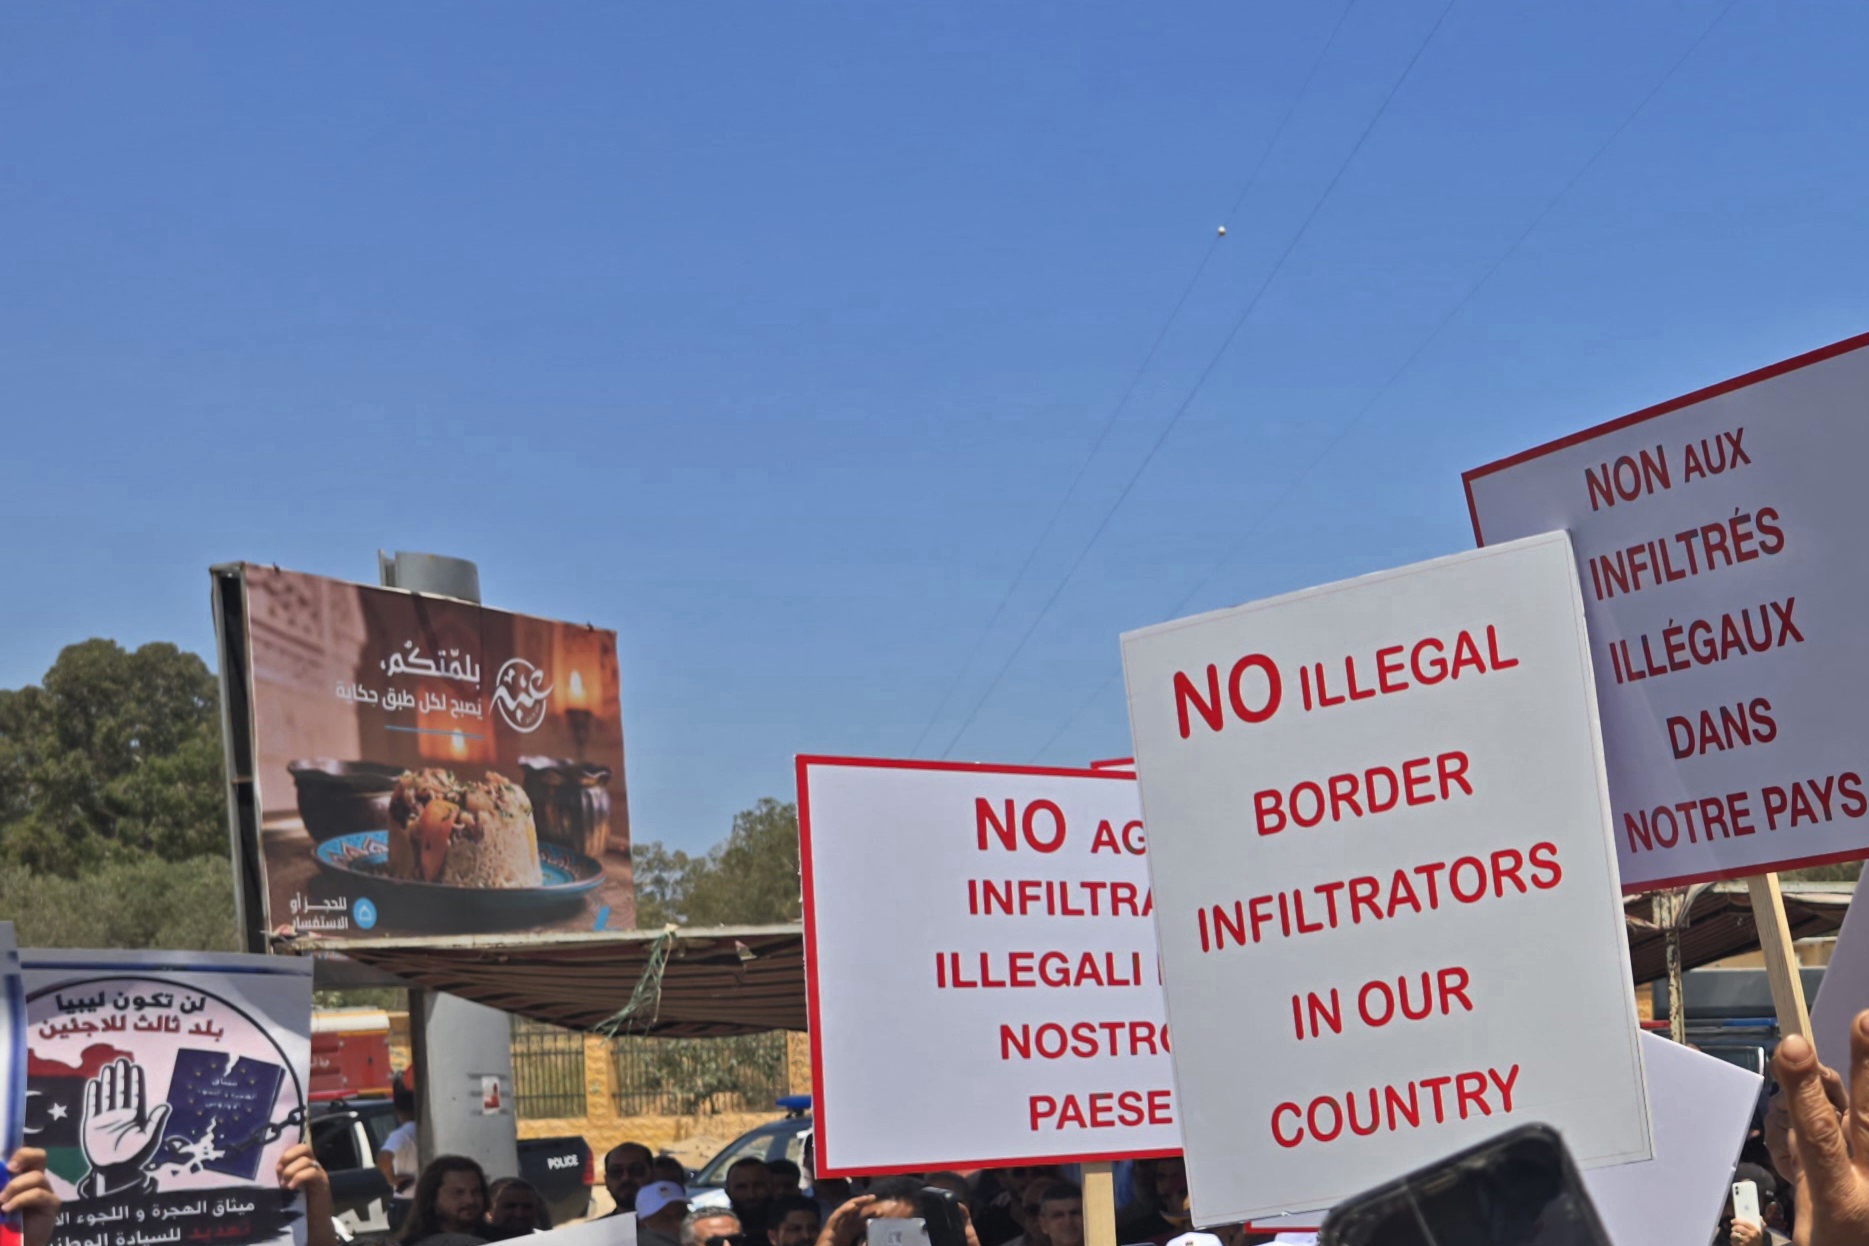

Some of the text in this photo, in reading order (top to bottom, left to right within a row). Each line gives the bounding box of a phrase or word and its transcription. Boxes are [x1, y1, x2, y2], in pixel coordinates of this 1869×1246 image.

[1584, 427, 1752, 511] NON AUX
[1588, 506, 1786, 602] INFILTRÉS
[1608, 596, 1805, 685] ILLÉGAUX
[382, 688, 415, 710] طبق
[1172, 624, 1519, 740] NO ILLEGAL
[419, 692, 446, 714] لكل
[1666, 697, 1778, 760] DANS
[1253, 749, 1473, 837] BORDER
[975, 798, 1146, 855] NO AG
[1623, 771, 1868, 854] NOTRE PAYS
[290, 891, 301, 915] أو
[1198, 842, 1563, 953] INFILTRATORS
[293, 915, 348, 930] الاستفسار
[936, 951, 1141, 988] ILLEGALI
[55, 991, 207, 1014] لن تكون ليبيا
[1291, 966, 1474, 1040] IN OUR
[39, 1013, 224, 1042] بلد ثالث للاجئين
[1029, 1089, 1173, 1131] PAESE
[1270, 1063, 1521, 1148] COUNTRY
[547, 1154, 579, 1172] POLICE
[76, 1206, 128, 1226] اللجوء
[136, 1209, 145, 1221] و
[152, 1201, 207, 1220] الهجرة
[212, 1198, 255, 1217] ميثاق
[116, 1227, 181, 1246] للسيادة
